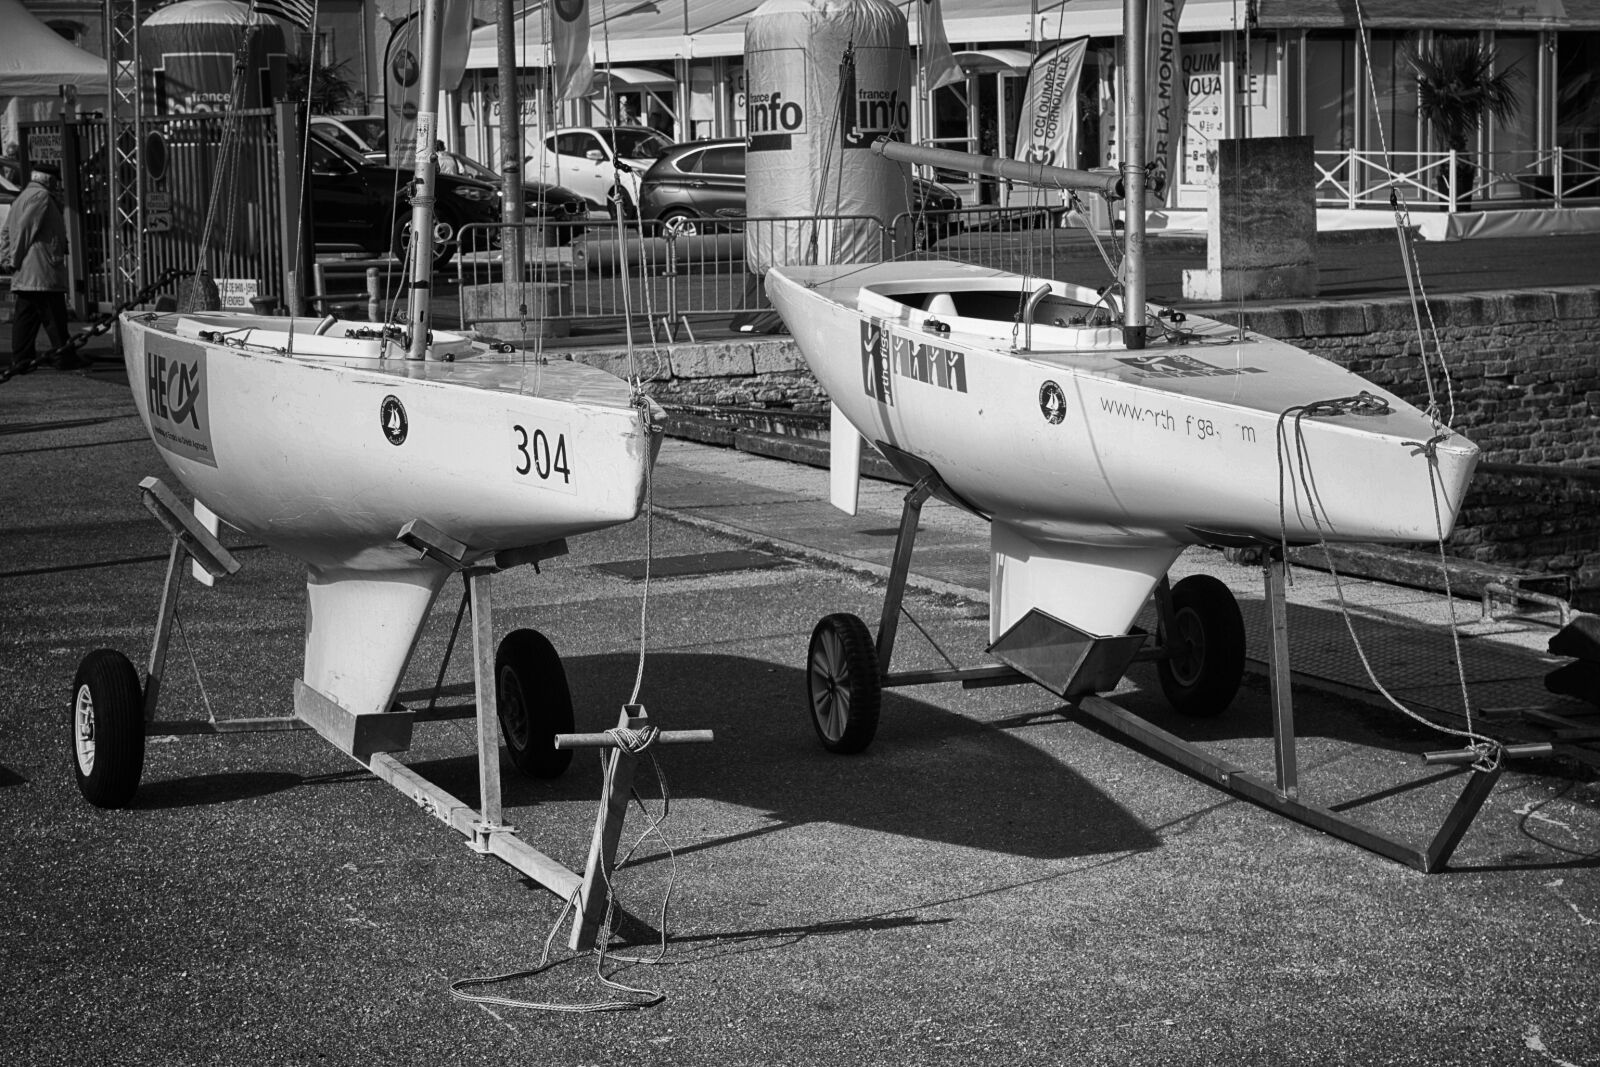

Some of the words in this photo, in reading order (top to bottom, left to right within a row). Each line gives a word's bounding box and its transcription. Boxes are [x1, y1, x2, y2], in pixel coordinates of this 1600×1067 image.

[750, 91, 804, 132] info
[858, 88, 890, 99] france
[859, 89, 909, 130] info
[1046, 56, 1071, 140] CORNOUAILLE
[1033, 114, 1047, 138] CCI
[1157, 104, 1170, 134] LA
[513, 424, 571, 484] 304
